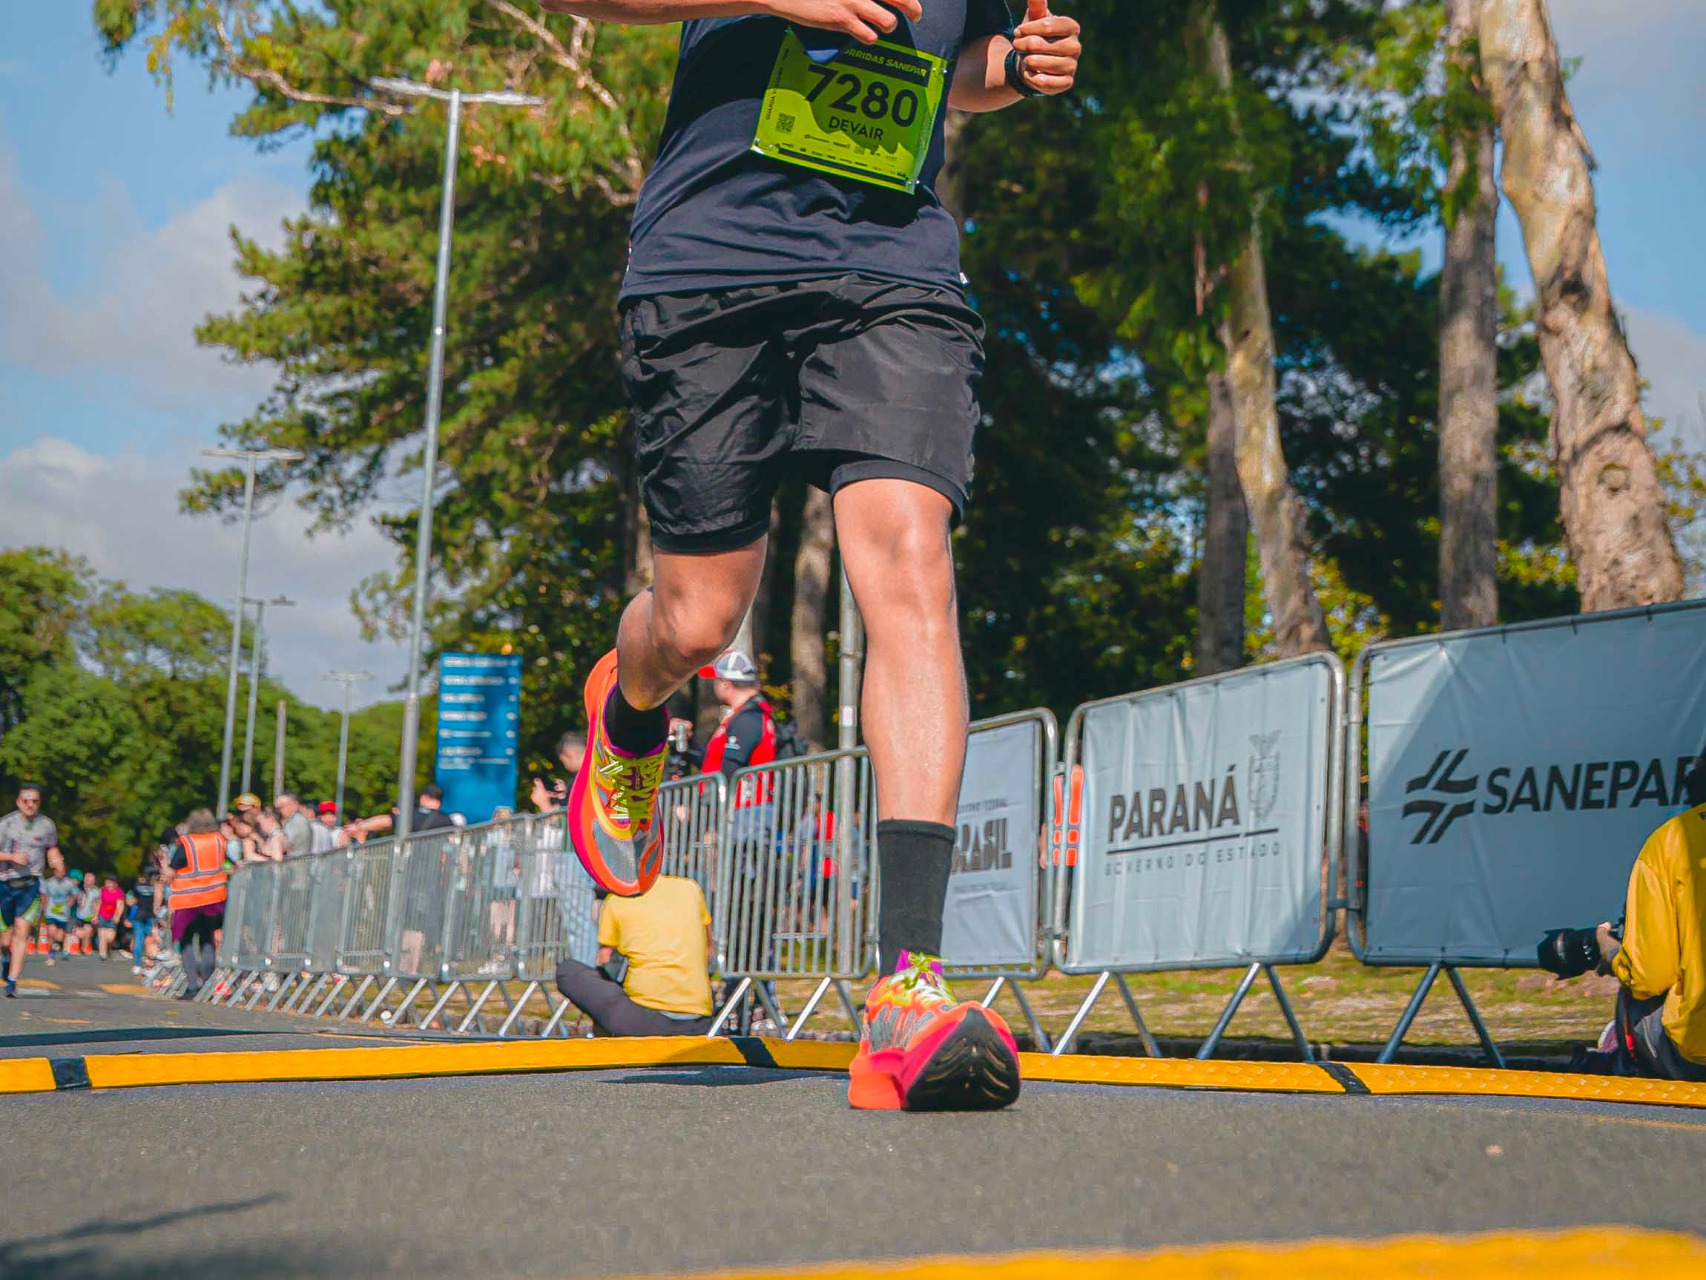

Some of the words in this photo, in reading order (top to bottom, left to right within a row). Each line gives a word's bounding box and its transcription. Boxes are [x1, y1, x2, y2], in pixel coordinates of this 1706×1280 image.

[886, 58, 928, 78] SANEPAR
[804, 64, 918, 128] 7280
[828, 116, 884, 141] DEVAIR
[1107, 763, 1241, 844] PARANÁ
